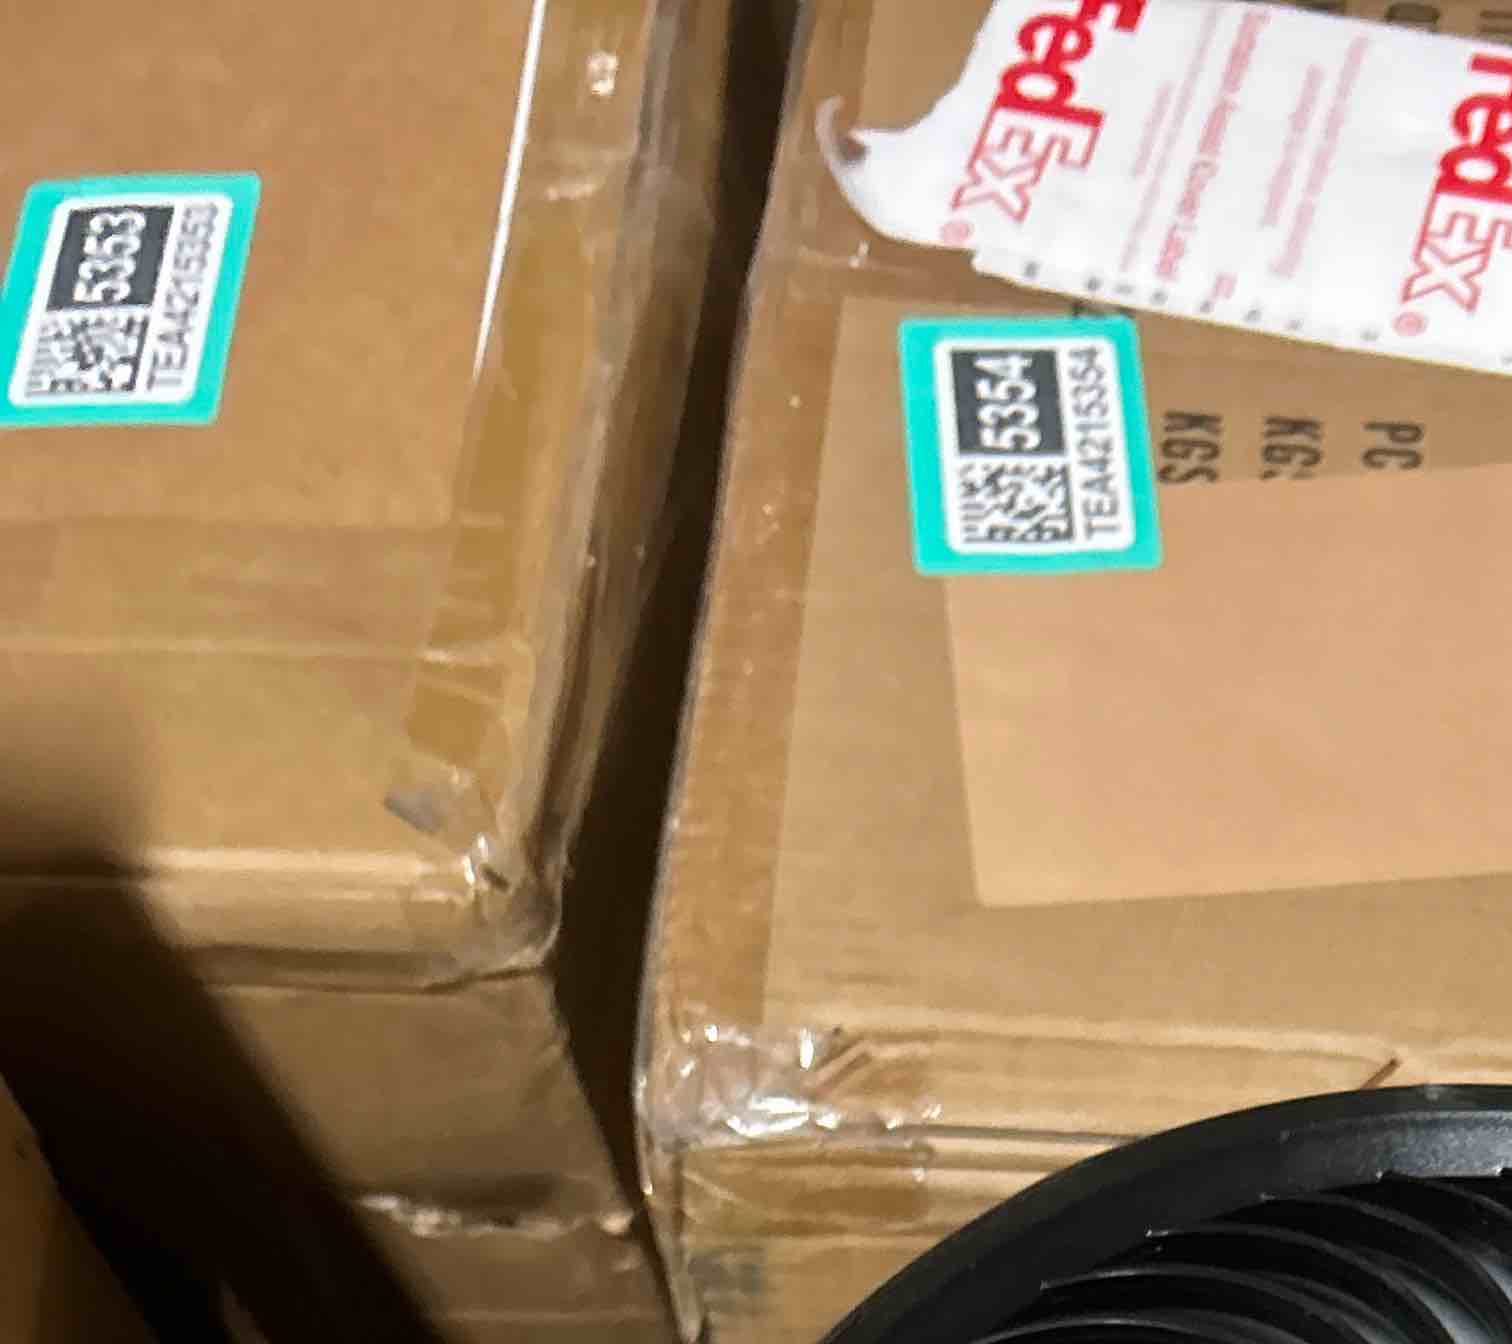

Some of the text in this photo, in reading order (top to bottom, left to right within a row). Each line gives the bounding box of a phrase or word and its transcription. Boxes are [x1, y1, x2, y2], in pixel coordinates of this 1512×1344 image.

[74, 208, 148, 306] 5353
[975, 353, 1046, 455] 5354
[1068, 344, 1127, 540] TEA4215354
[1158, 410, 1222, 485] KGS
